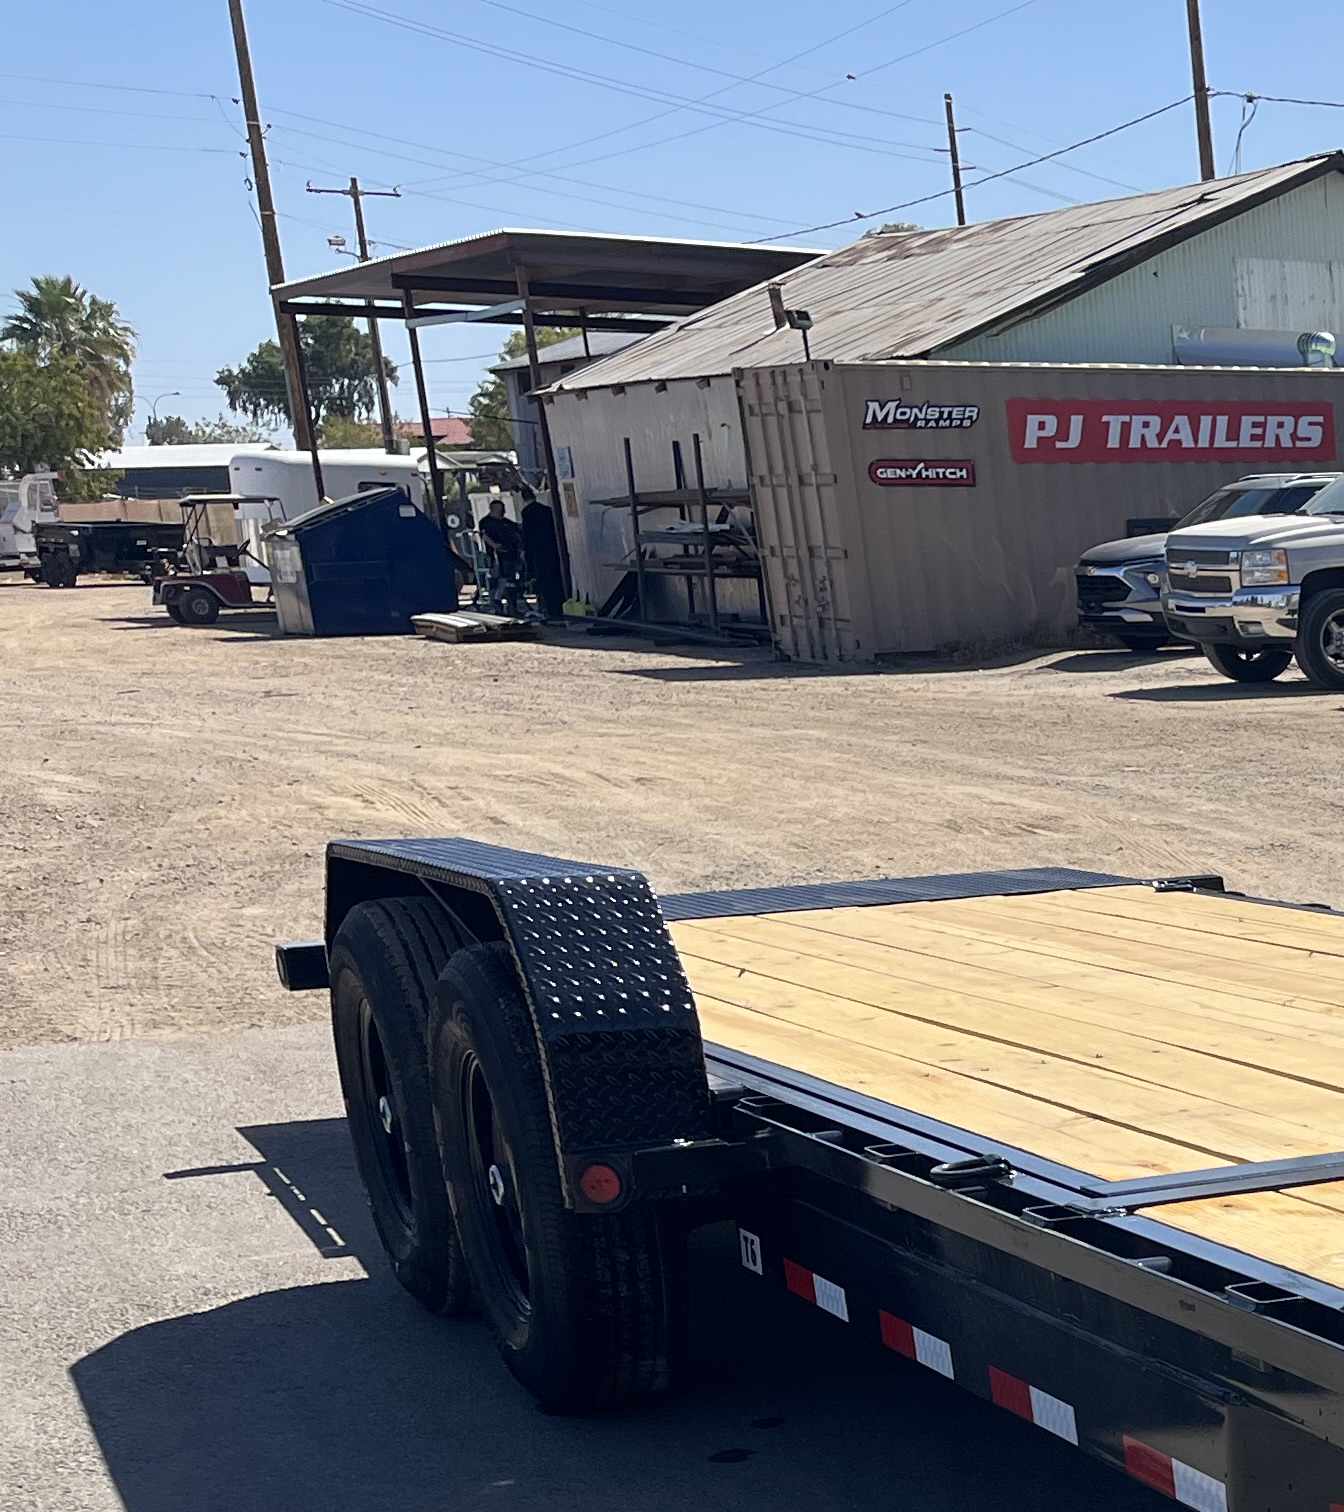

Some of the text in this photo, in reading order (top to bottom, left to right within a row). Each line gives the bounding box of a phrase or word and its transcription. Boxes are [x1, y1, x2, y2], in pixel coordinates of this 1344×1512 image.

[865, 400, 979, 424] MONSTER
[916, 420, 972, 428] RAMPS
[1023, 414, 1324, 449] PJ TRAILERS
[921, 468, 967, 479] HITCH
